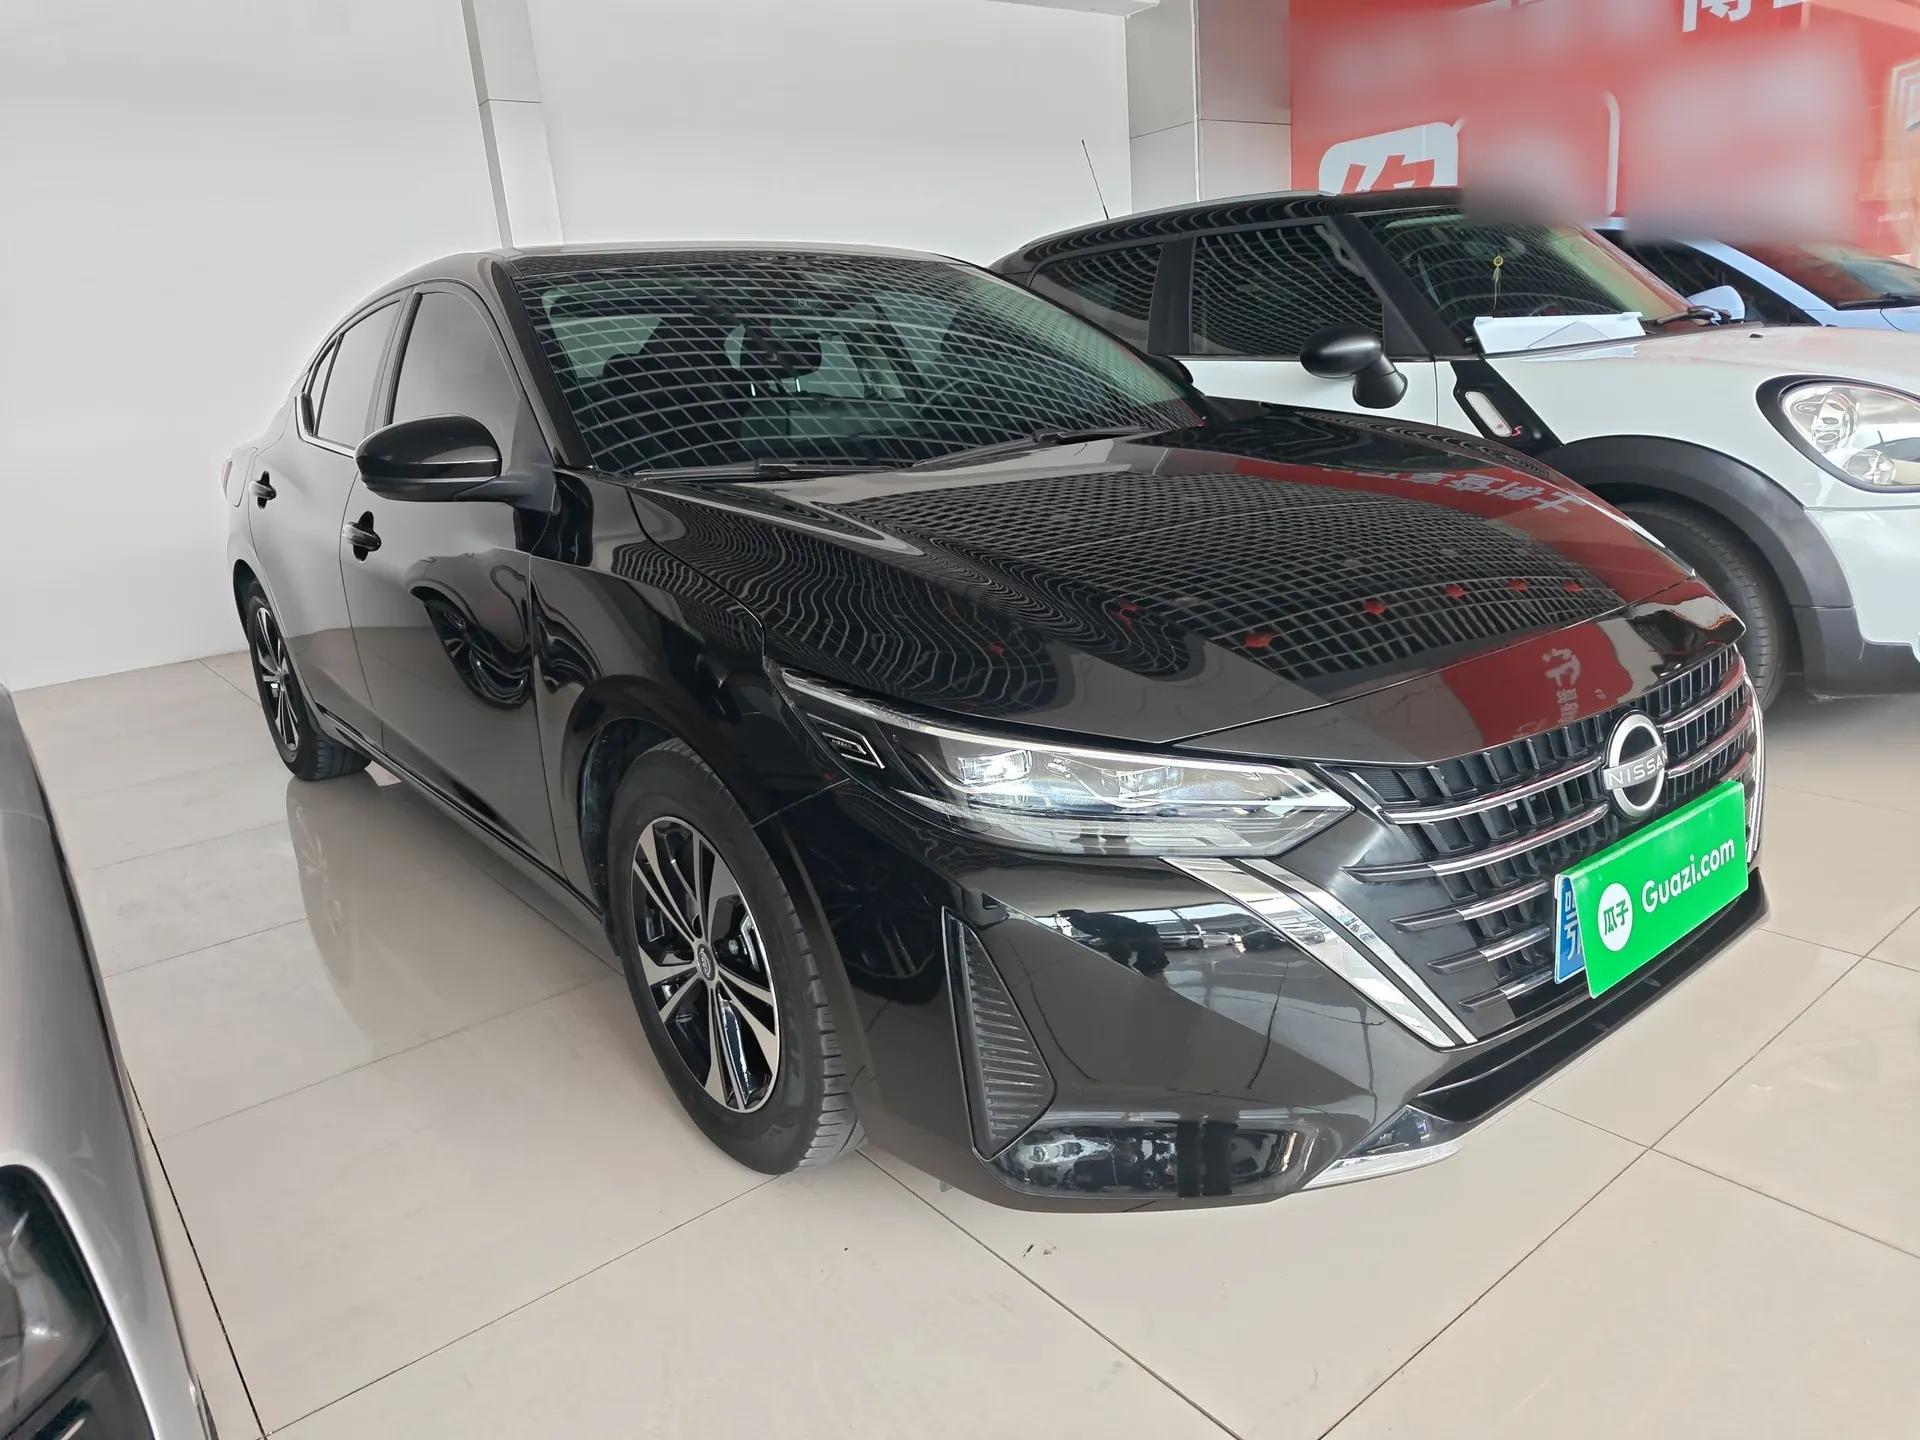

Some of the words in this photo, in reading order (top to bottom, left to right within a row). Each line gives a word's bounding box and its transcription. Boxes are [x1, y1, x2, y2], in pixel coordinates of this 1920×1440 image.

[1608, 749, 1668, 787] NISSAN
[1603, 899, 1629, 936] 瓜子
[1642, 838, 1735, 913] Guazi.com
